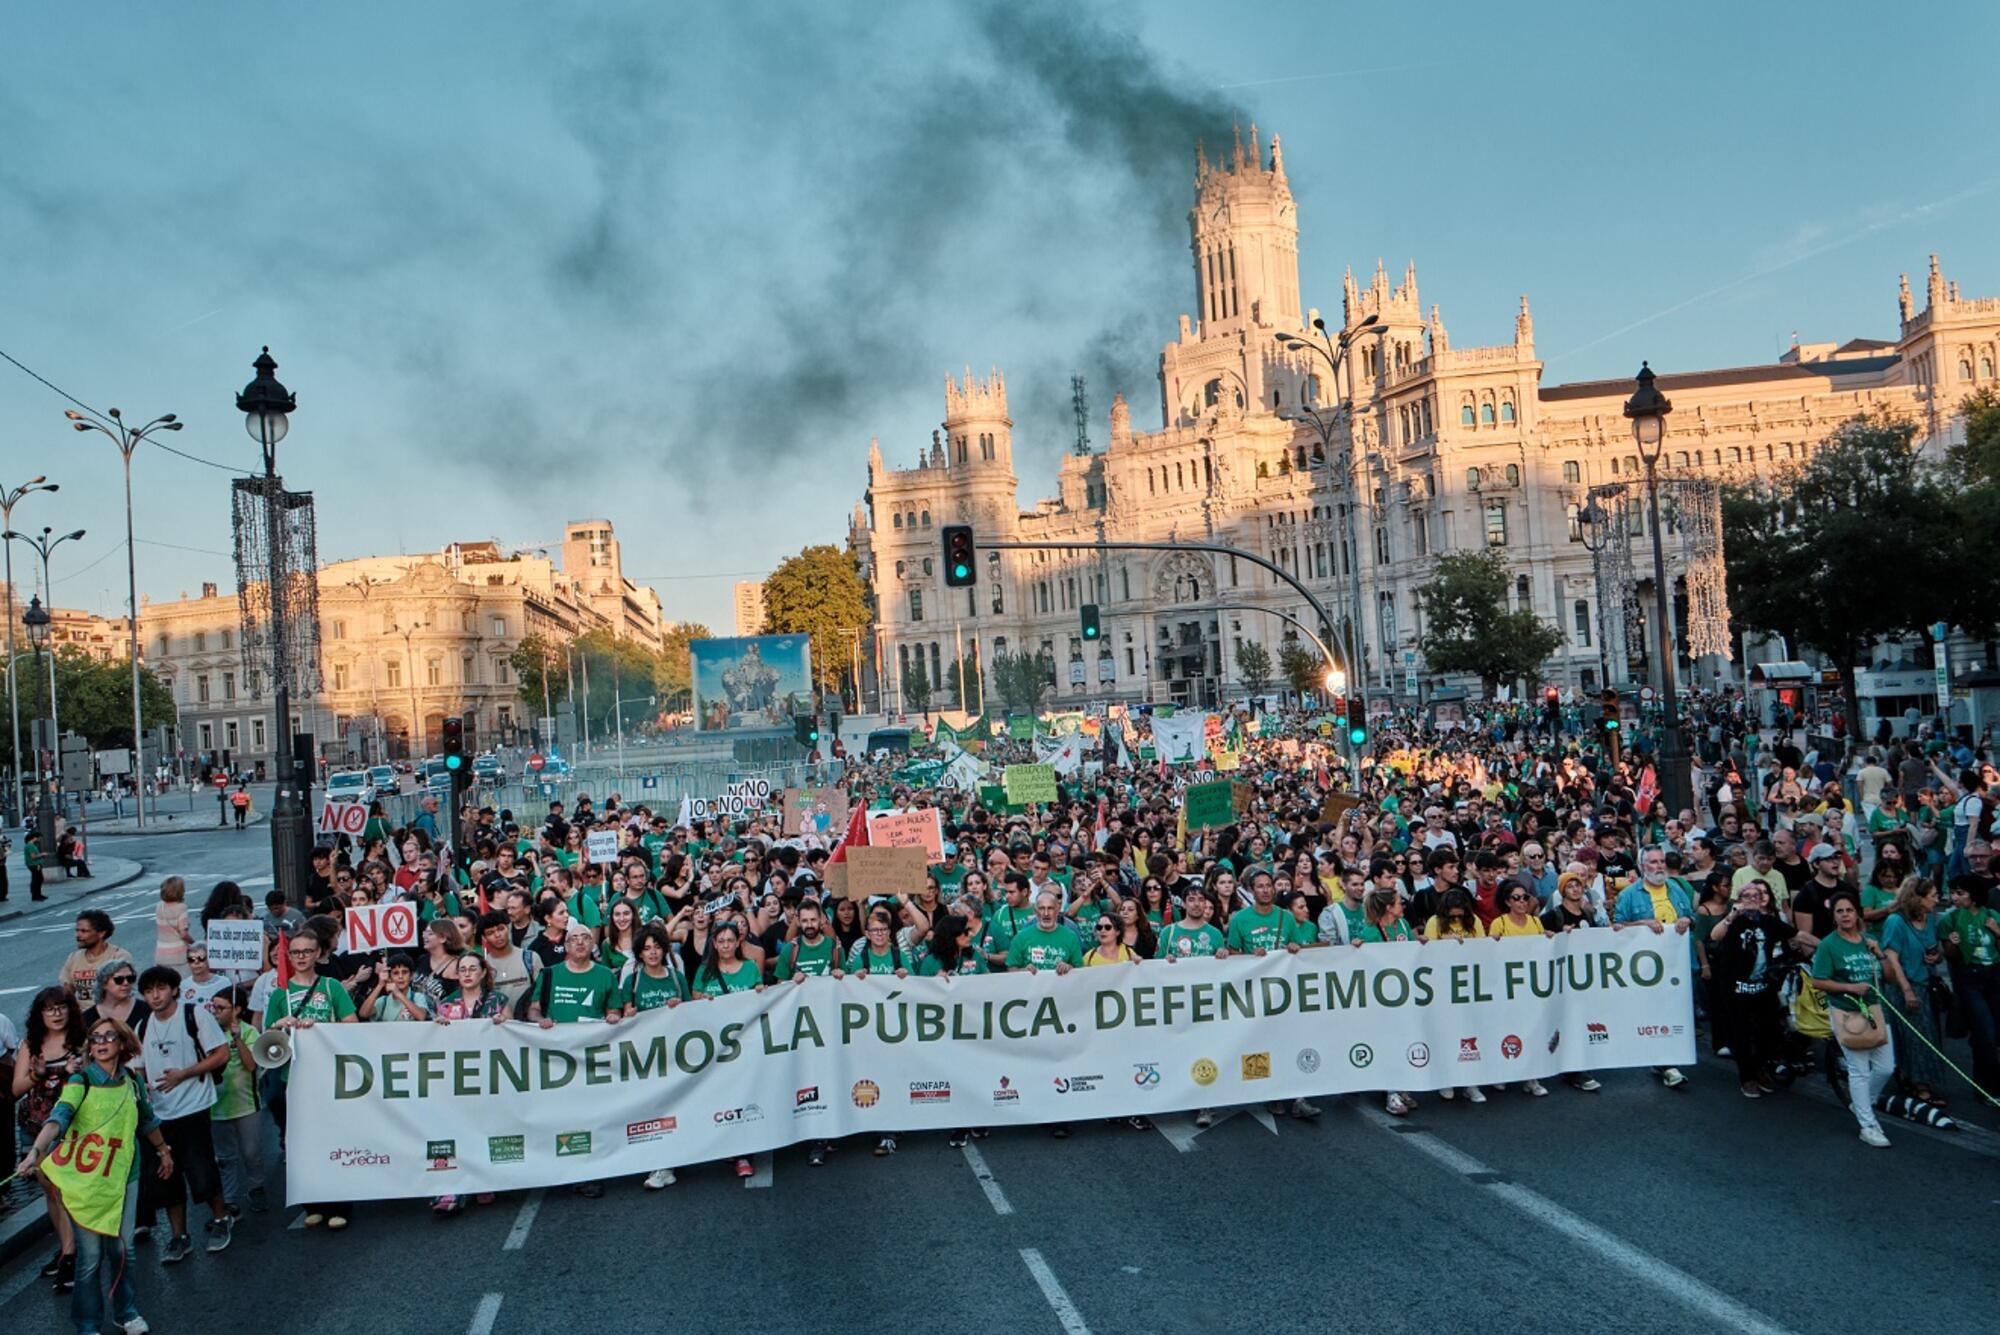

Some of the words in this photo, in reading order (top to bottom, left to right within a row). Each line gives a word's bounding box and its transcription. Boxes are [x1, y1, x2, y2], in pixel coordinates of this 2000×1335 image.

[745, 780, 768, 796] NO
[720, 797, 743, 812] NO
[322, 804, 366, 832] NO
[907, 813, 932, 824] AULAS
[350, 905, 415, 950] NO
[334, 1023, 743, 1099] DEFENDEMOS
[761, 1005, 824, 1055] LA
[841, 991, 1077, 1044] PÚBLICA.
[1095, 966, 1433, 1030] DEFENDEMOS
[1450, 965, 1492, 1003] EL
[1506, 950, 1680, 1000] FUTURO.
[1638, 1026, 1659, 1036] UGT
[1589, 1033, 1609, 1041] STEM
[910, 1081, 951, 1091] CONFAPA
[713, 1108, 743, 1123] CGT
[51, 1130, 122, 1177] UGT
